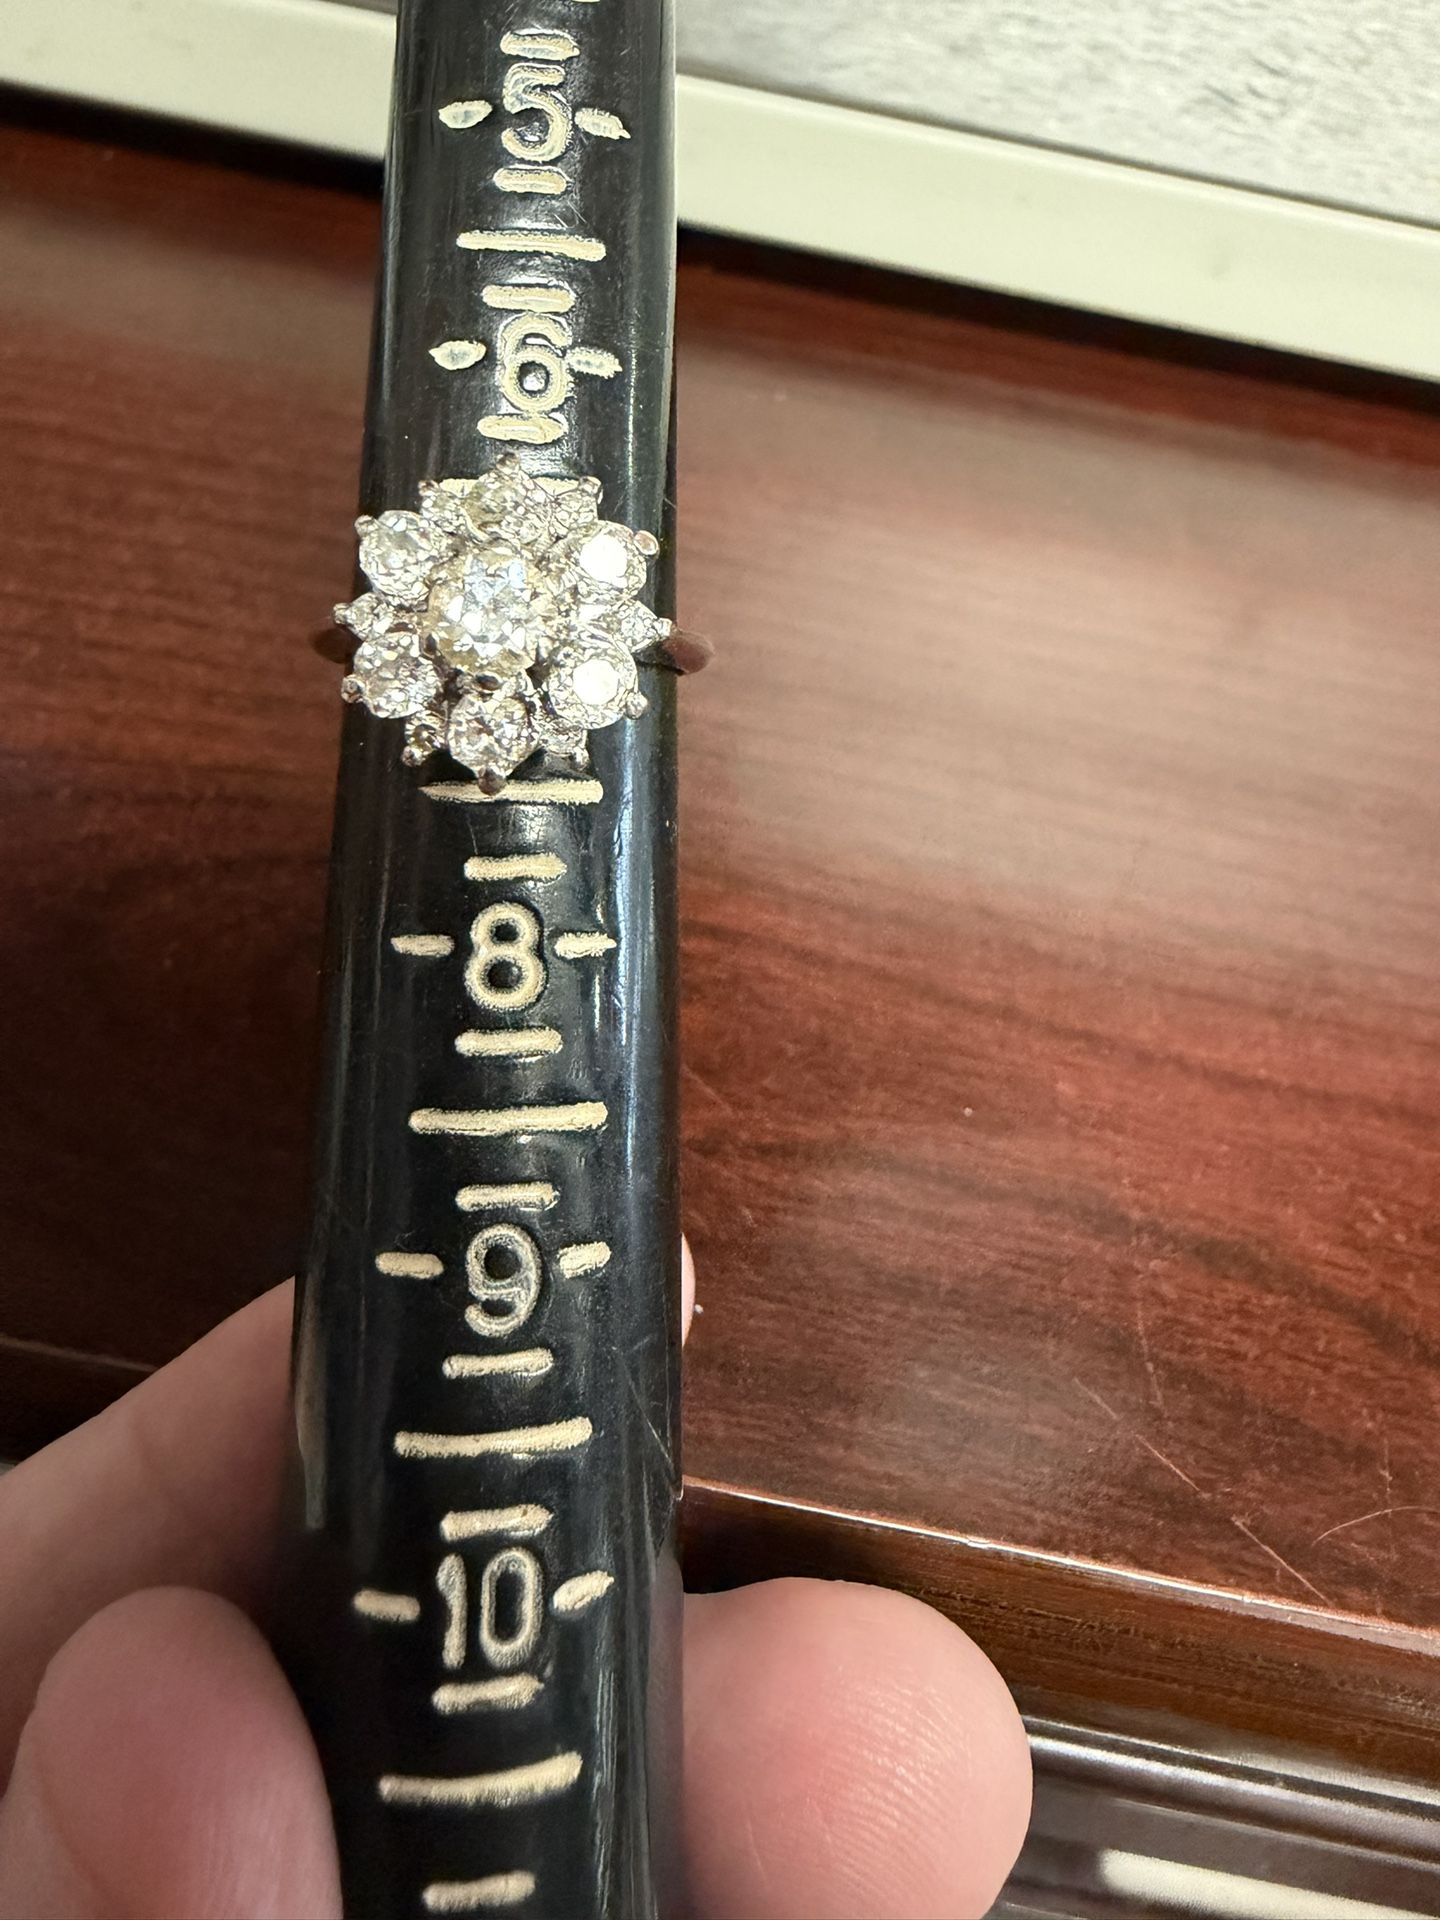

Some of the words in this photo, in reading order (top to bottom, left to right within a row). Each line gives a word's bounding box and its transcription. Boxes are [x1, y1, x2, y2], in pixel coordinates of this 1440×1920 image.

[502, 62, 573, 162] 5
[498, 313, 572, 412] 6
[464, 902, 541, 1011] 8
[464, 1223, 541, 1336] 9
[435, 1545, 542, 1668] 10
